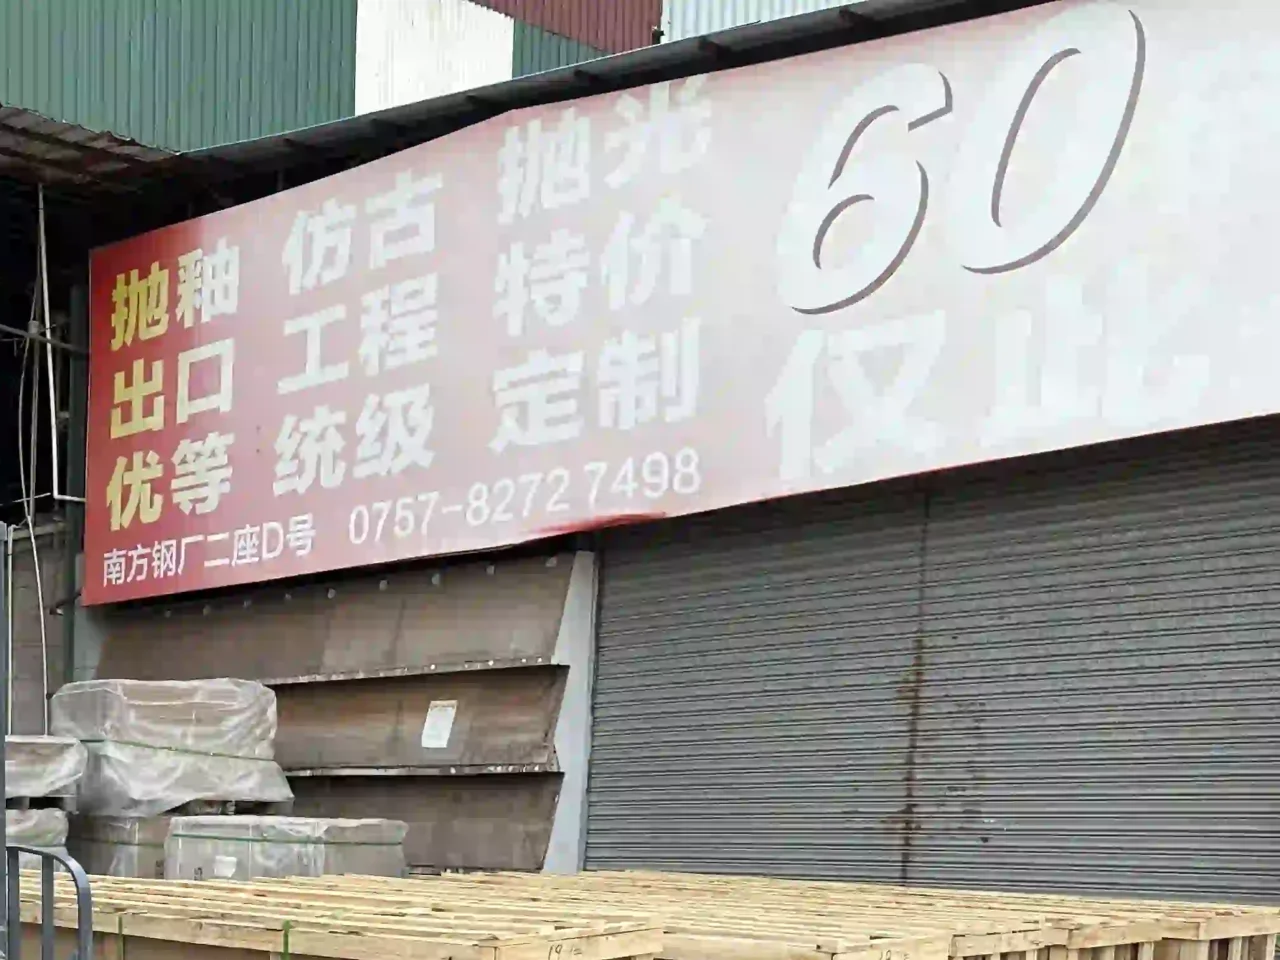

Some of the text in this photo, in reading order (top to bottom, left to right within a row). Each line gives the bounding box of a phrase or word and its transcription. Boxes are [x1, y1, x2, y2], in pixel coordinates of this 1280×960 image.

[109, 194, 713, 440] 出口 工程 特价
[110, 72, 713, 352] 抛釉 仿古 抛光
[105, 315, 703, 532] 优等 统级 定制
[102, 513, 317, 589] 南方钢厂二座D号
